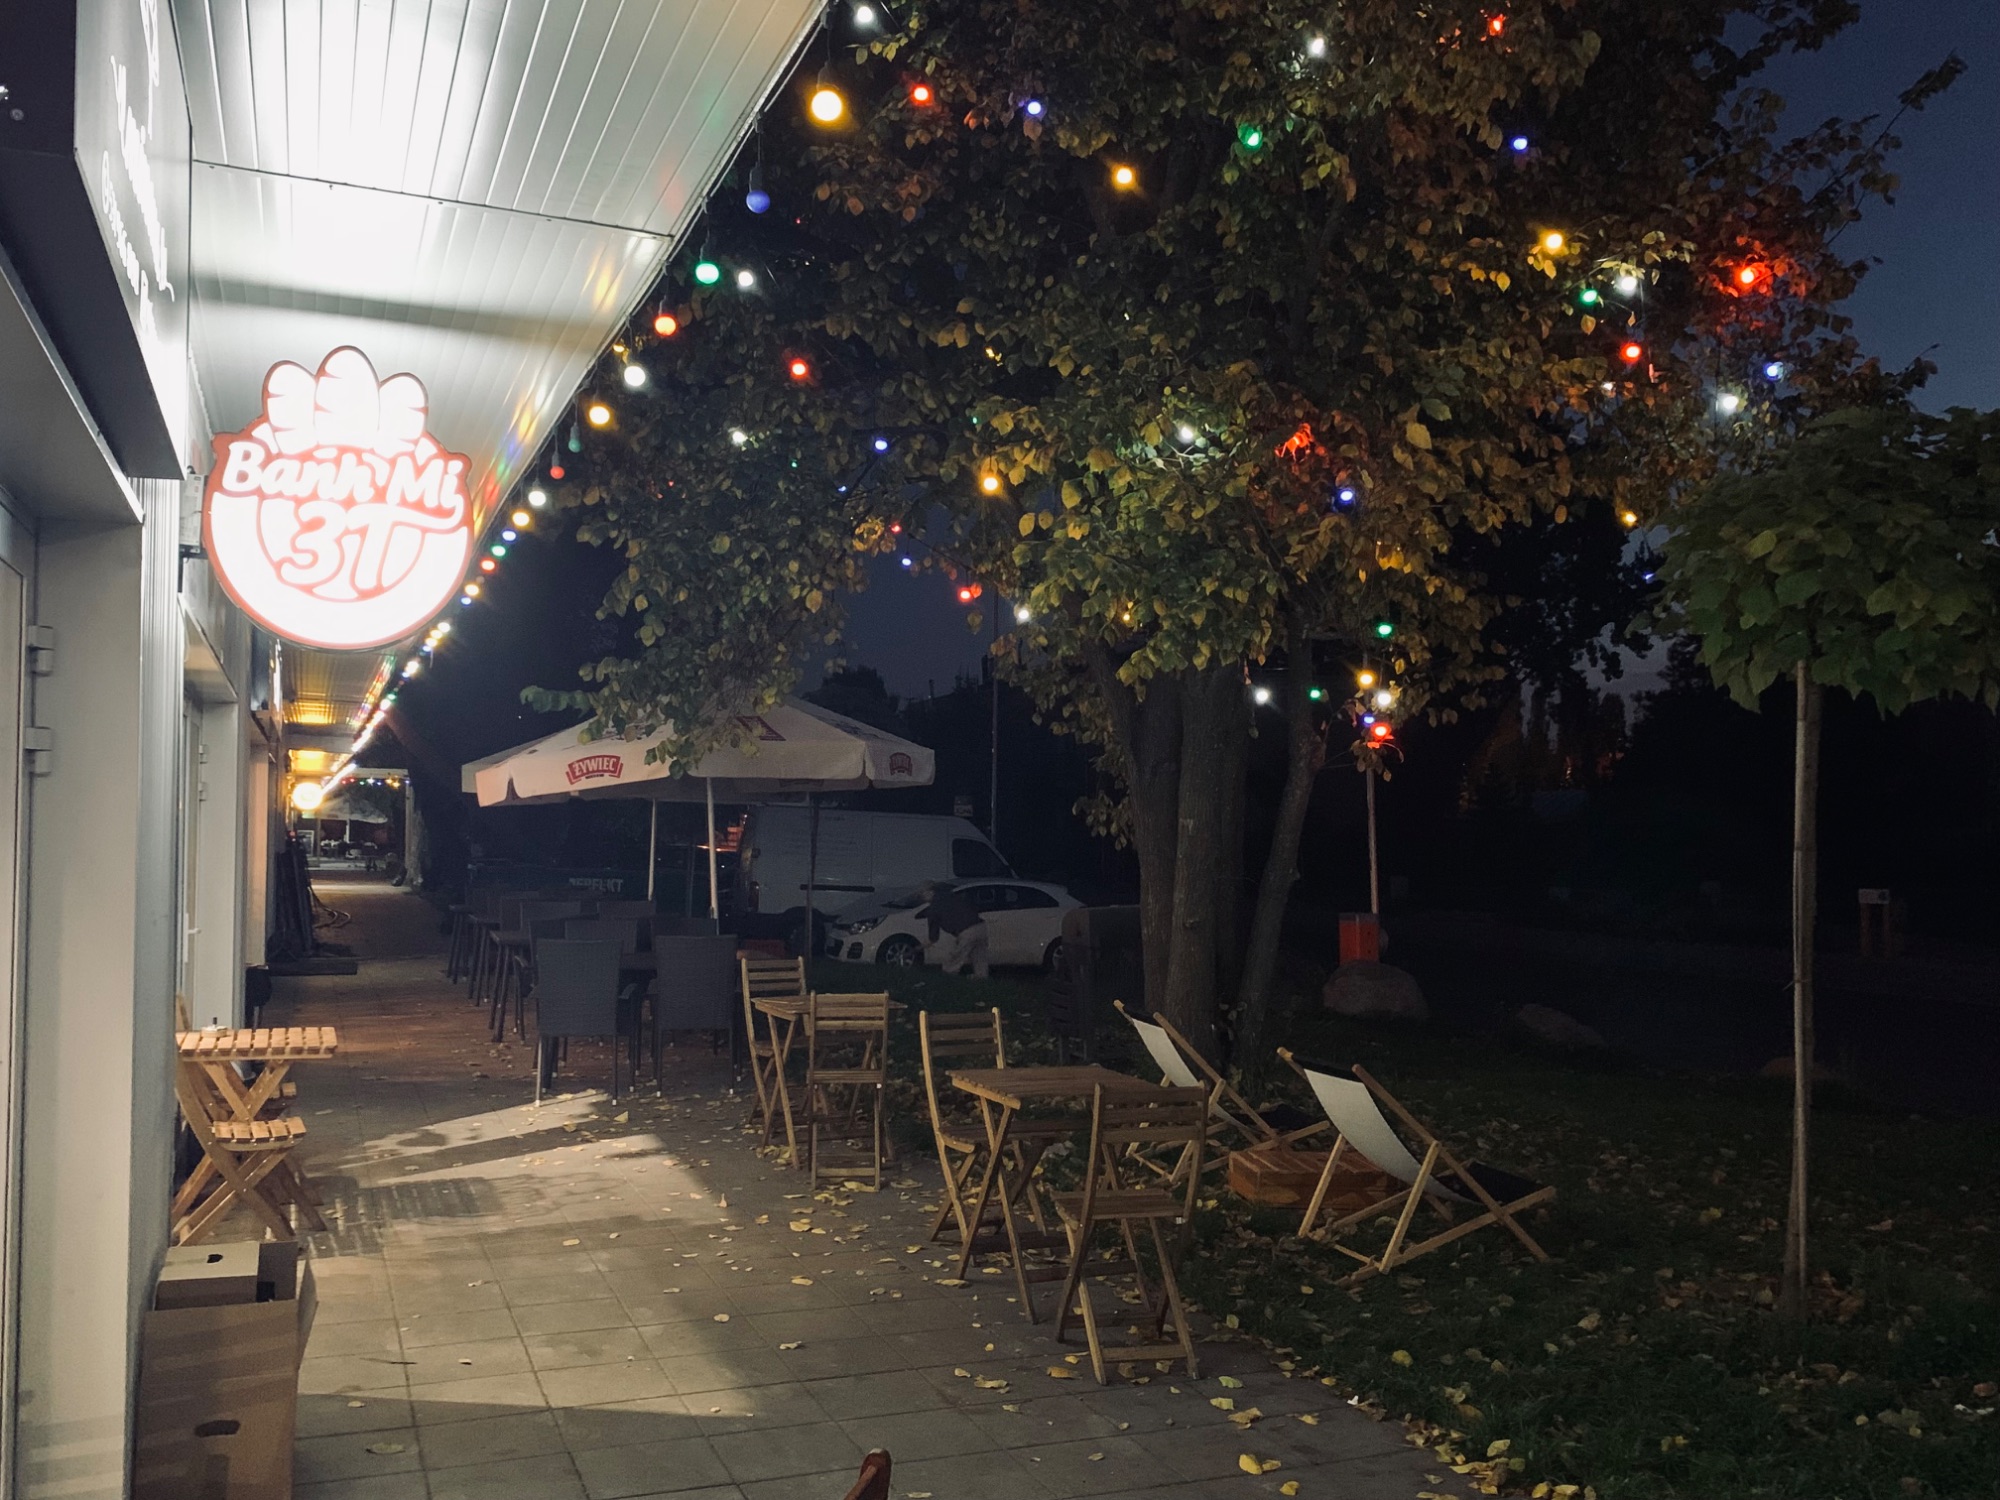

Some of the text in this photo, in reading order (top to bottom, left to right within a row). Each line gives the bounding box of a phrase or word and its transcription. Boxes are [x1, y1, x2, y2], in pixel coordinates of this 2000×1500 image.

[386, 455, 463, 508] Mi
[280, 500, 463, 590] 3T
[573, 757, 616, 776] ŻYWIEC
